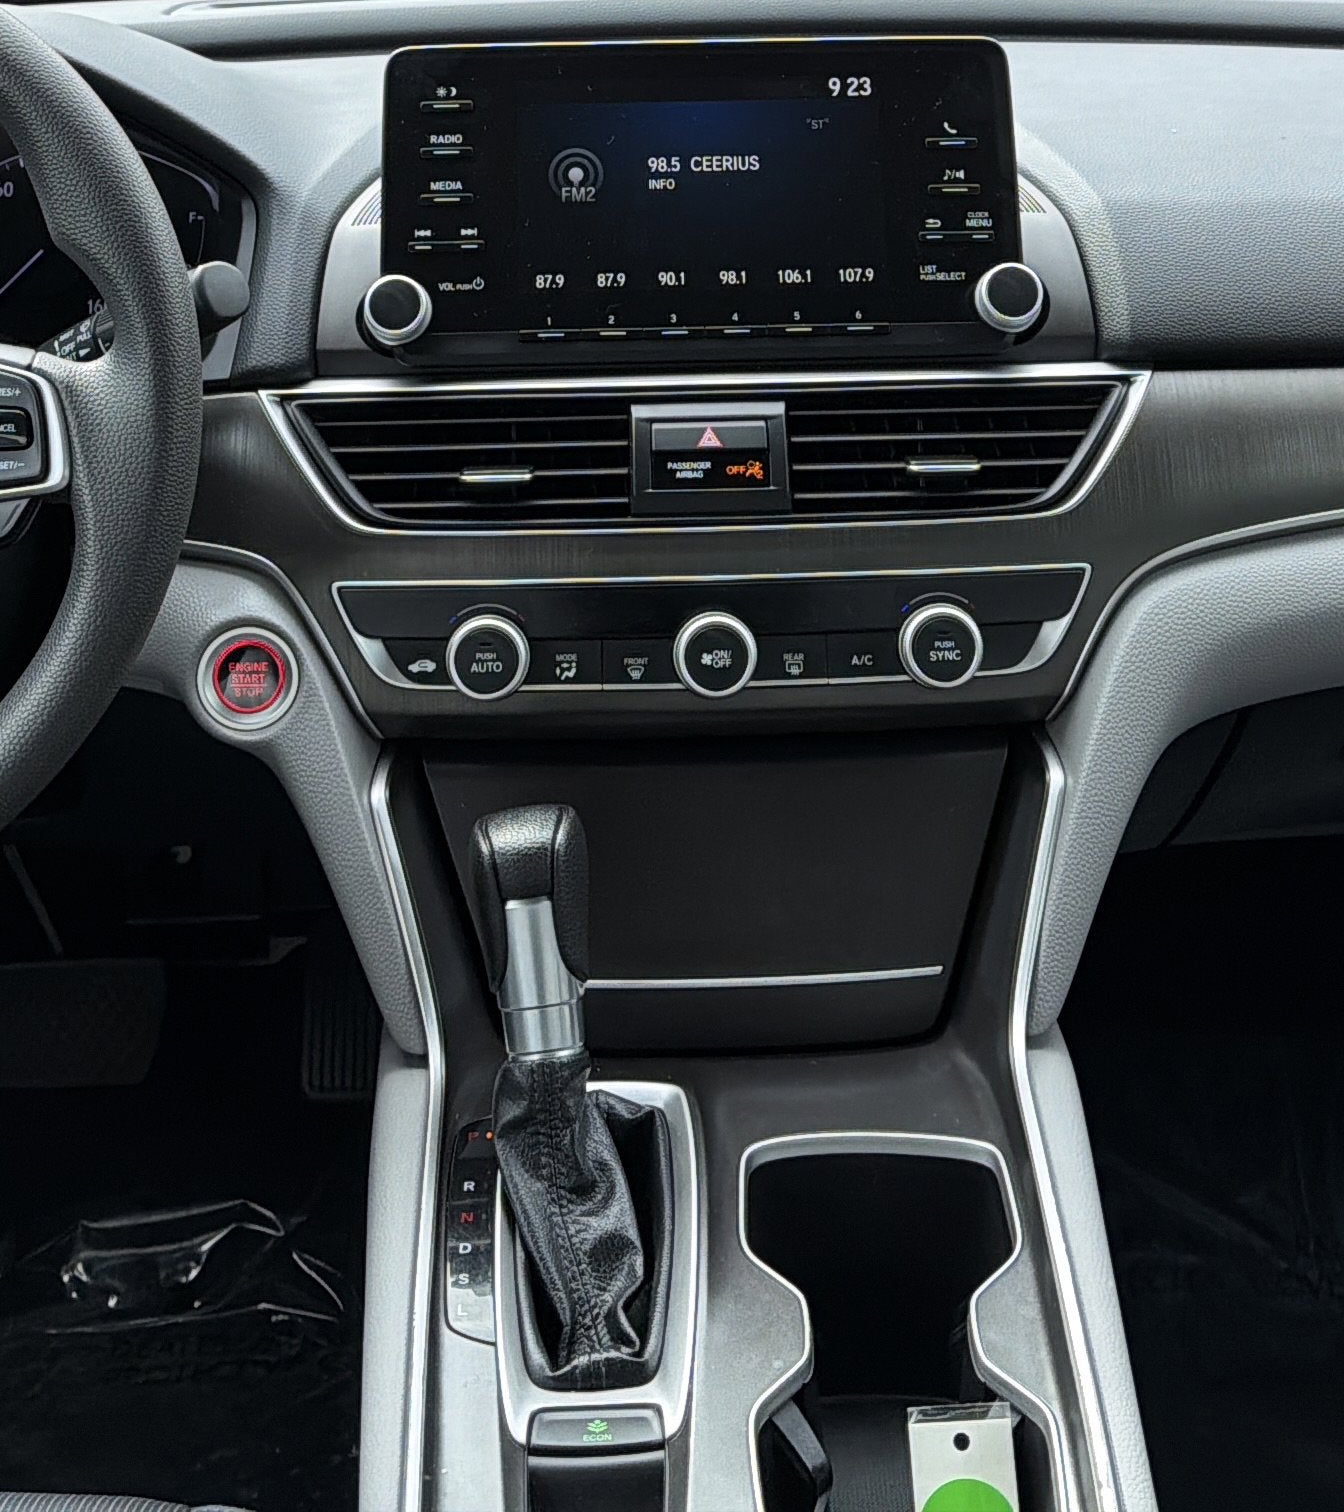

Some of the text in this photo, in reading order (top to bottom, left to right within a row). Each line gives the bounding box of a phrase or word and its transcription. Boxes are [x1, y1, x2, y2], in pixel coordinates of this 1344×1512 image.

[430, 134, 463, 144] RADIO
[647, 155, 760, 173] 98.5 CEERIUS
[430, 181, 463, 191] MEDIA
[648, 178, 675, 190] INFO
[561, 187, 596, 203] FM2
[188, 212, 197, 224] F
[967, 211, 989, 219] CLOCK
[965, 218, 993, 227] MENU
[919, 264, 937, 274] LIST
[535, 268, 875, 289] 87.9 87.9 90.1 98.1 106.1 107.9
[936, 271, 966, 281] SELECT
[438, 282, 455, 292] VOL
[607, 315, 615, 324] 2
[670, 313, 677, 323] 3
[731, 312, 739, 322] 4
[793, 311, 801, 320] 5
[855, 310, 862, 320] 6
[60, 341, 76, 356] OFF
[667, 461, 712, 471] PASSENGER
[725, 465, 746, 475] OFF
[675, 470, 704, 479] AIRBAG
[934, 640, 955, 649] PUSH
[476, 652, 497, 660] PUSH
[556, 653, 578, 662] MODE
[712, 649, 733, 660] ON/
[783, 653, 804, 662] REAR
[851, 654, 873, 666] A/C
[929, 650, 962, 662] SYNC
[228, 661, 270, 673] ENGINE
[623, 657, 649, 666] FRONT
[712, 659, 733, 669] OFF
[470, 661, 503, 674] AUTO
[231, 673, 265, 684] START
[233, 687, 264, 698] STOP
[466, 1131, 479, 1141] P
[462, 1181, 475, 1193] R
[460, 1211, 474, 1223] N
[457, 1242, 472, 1255] D
[457, 1273, 470, 1285] S
[457, 1304, 467, 1316] L
[582, 1433, 613, 1442] ECON
